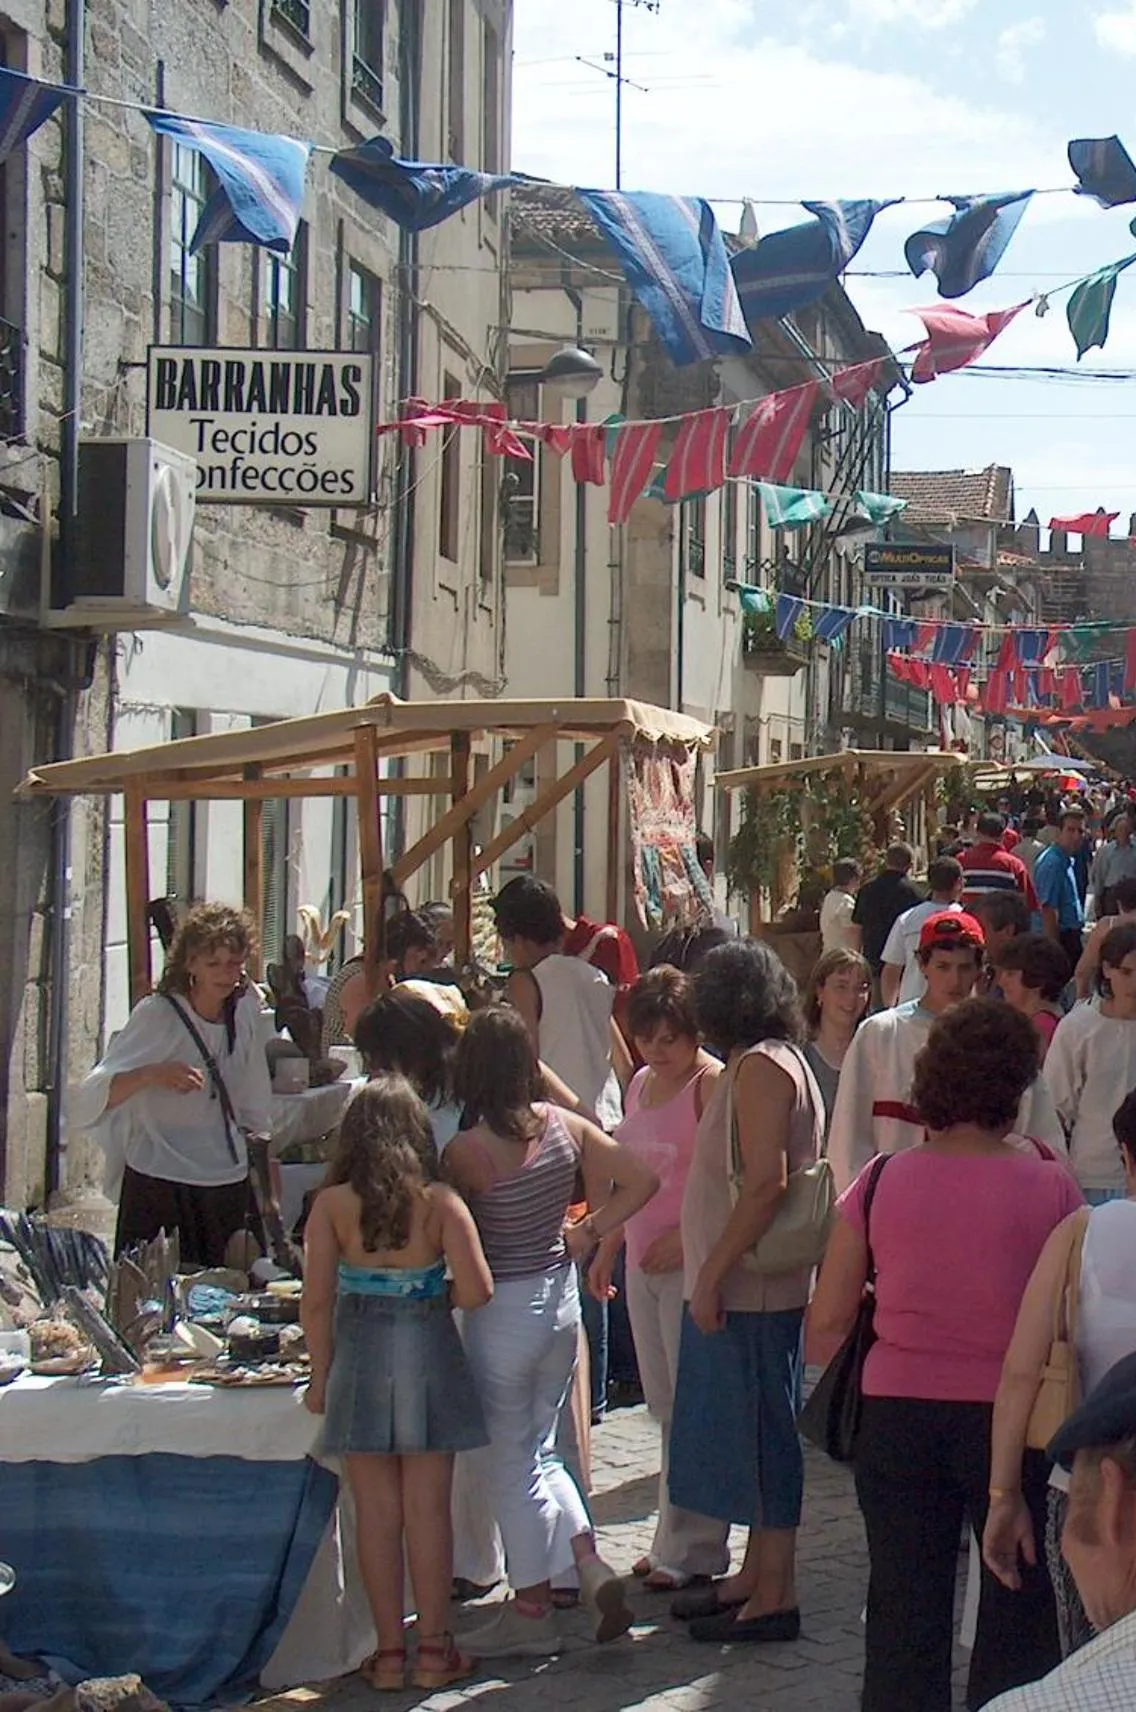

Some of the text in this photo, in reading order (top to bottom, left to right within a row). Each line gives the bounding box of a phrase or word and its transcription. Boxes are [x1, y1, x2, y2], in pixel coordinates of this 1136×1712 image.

[155, 358, 361, 417] BARRANHAS
[189, 418, 317, 456] Tecidos
[195, 457, 355, 495] nfecções
